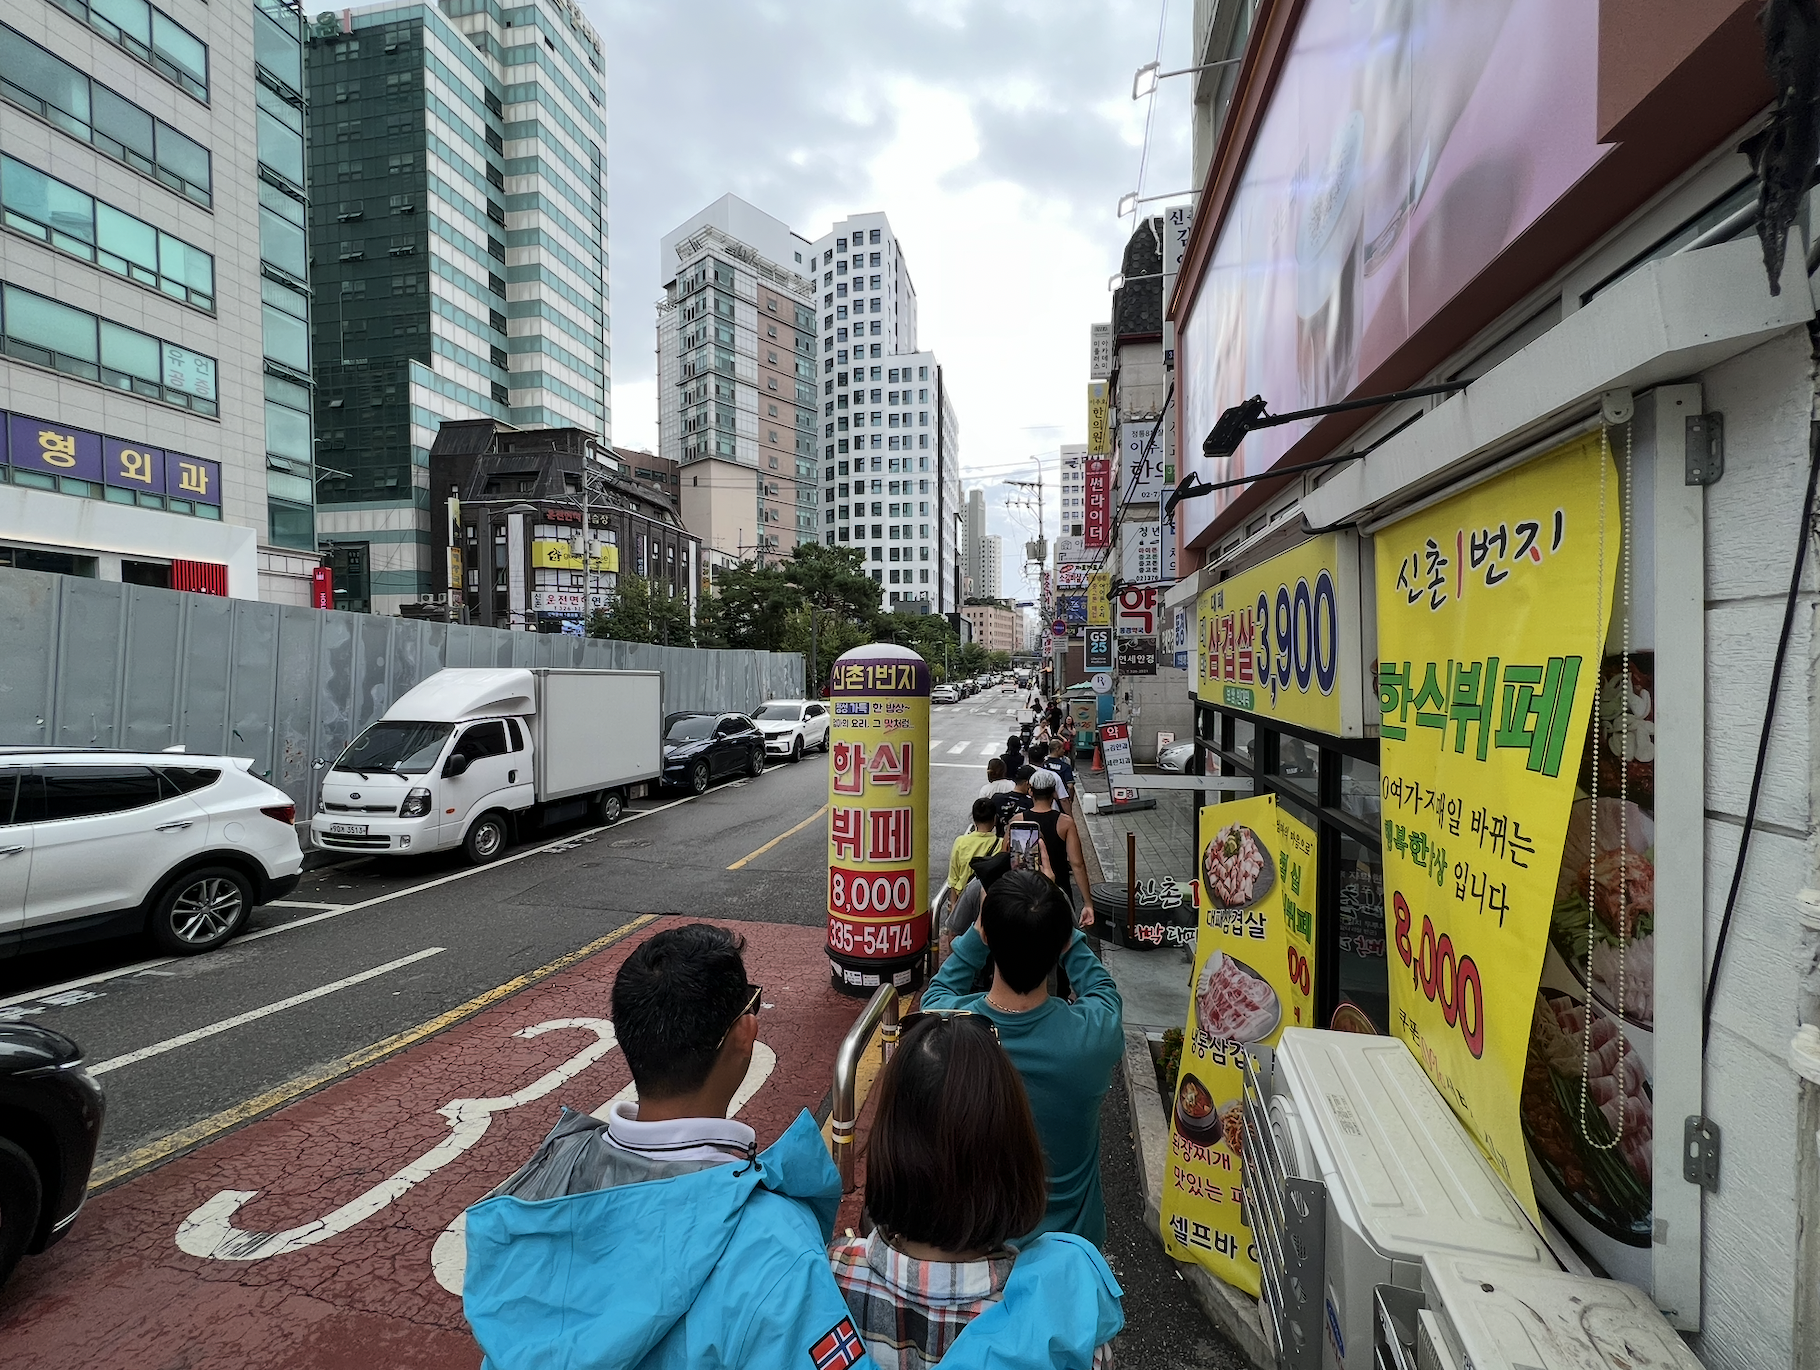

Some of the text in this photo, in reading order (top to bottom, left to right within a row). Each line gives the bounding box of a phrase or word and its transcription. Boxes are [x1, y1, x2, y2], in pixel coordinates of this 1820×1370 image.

[1089, 477, 1105, 541] 썬라이더
[1119, 586, 1158, 634] 약
[1090, 631, 1108, 642] GS
[1090, 642, 1108, 653] 25
[1208, 604, 1256, 686] 삼겹살
[1256, 568, 1339, 710] 3,900
[833, 664, 917, 691] 신촌1번지
[1118, 654, 1155, 665] 연세안경
[873, 703, 883, 714] 한
[873, 719, 881, 728] 그
[1379, 656, 1582, 778] 한식뷔페
[1106, 726, 1120, 739] 약
[833, 743, 912, 793] 한식
[832, 807, 910, 859] 뷔페
[1470, 807, 1536, 869] 바뀌는
[832, 873, 911, 912] 8,000
[1135, 876, 1183, 909] 신촌
[1453, 861, 1510, 928] 입니다
[829, 918, 912, 955] 335-5474
[1394, 891, 1484, 1060] 8,000
[1173, 1165, 1223, 1203] 맛있는
[1169, 1213, 1239, 1261] 셀프바
